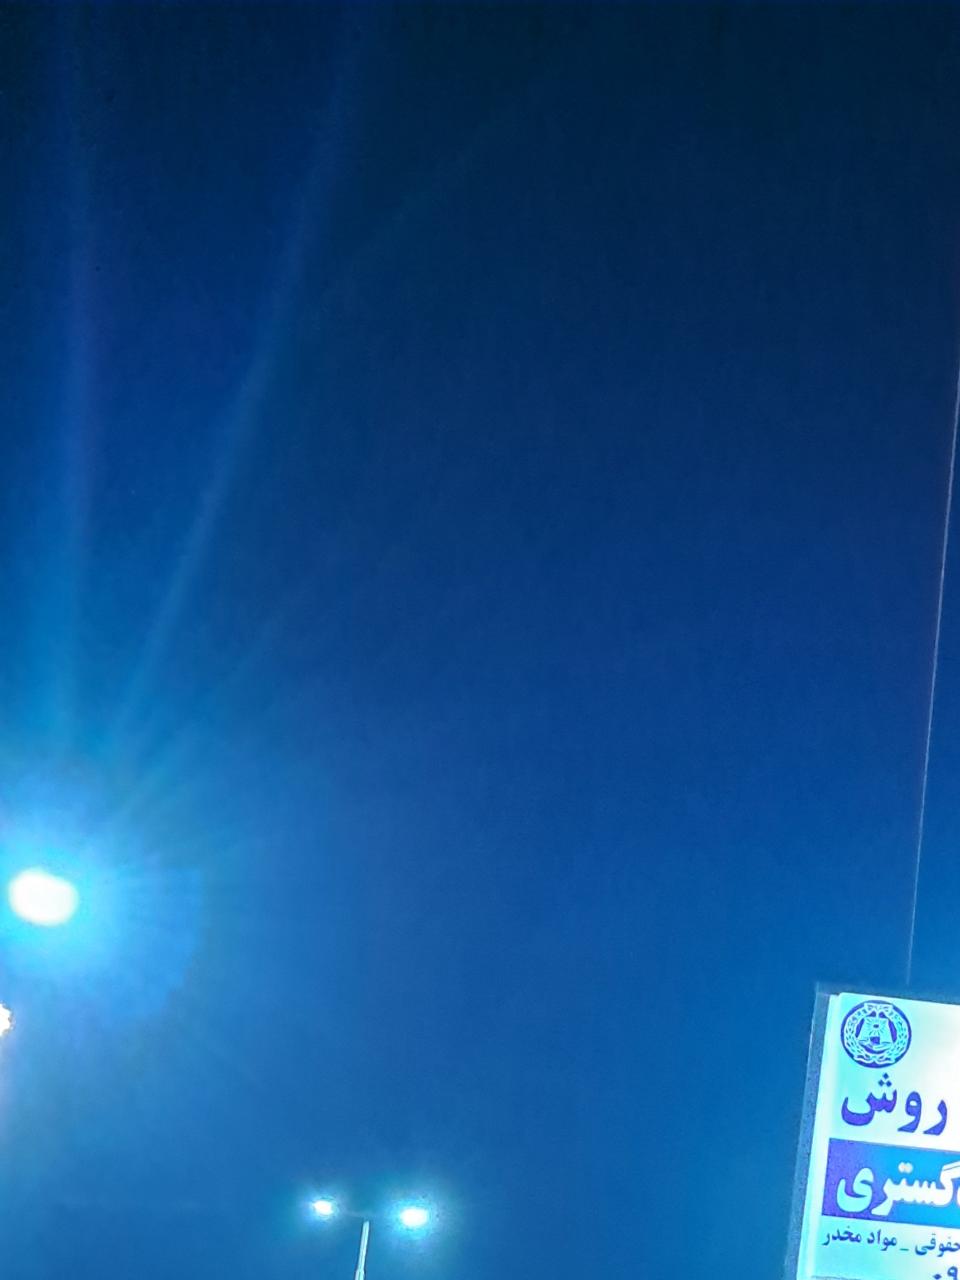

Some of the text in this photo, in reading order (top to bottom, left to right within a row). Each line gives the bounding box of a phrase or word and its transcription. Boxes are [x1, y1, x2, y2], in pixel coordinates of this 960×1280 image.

[841, 1072, 947, 1136] روش
[822, 1226, 862, 1246] مخدر
[867, 1229, 897, 1251] مواد
